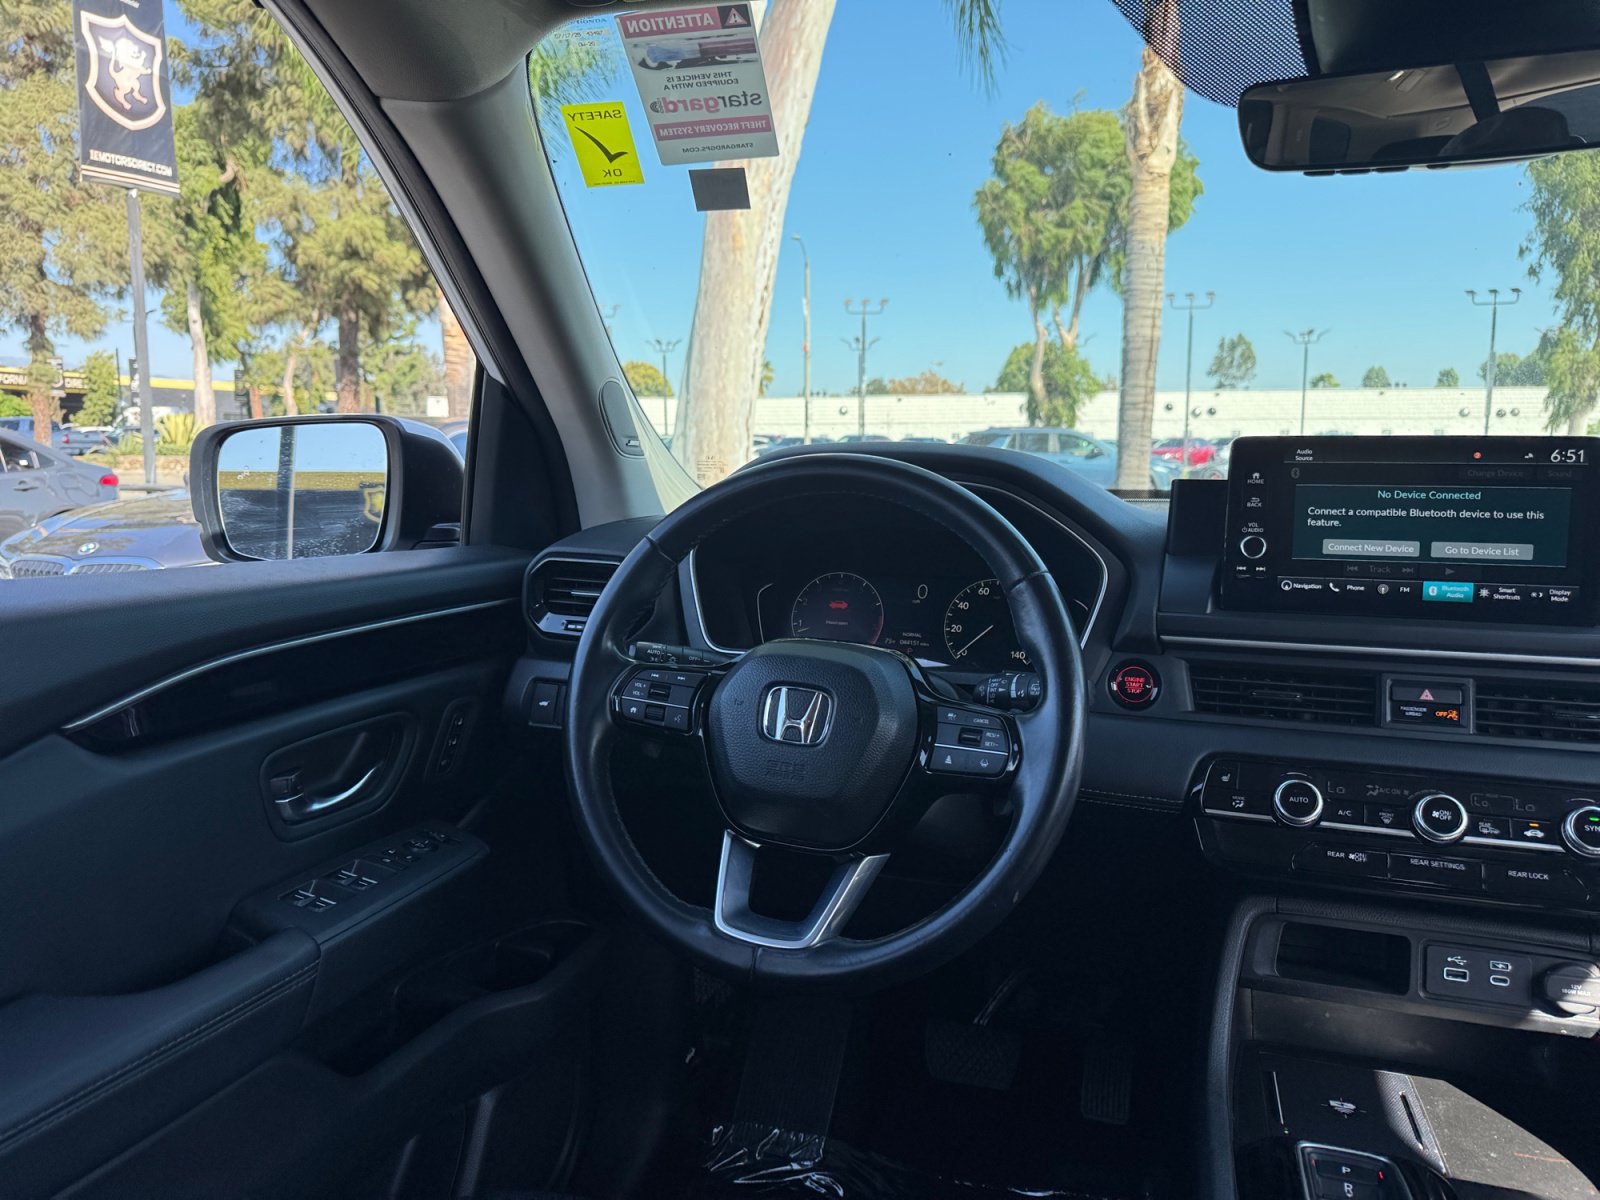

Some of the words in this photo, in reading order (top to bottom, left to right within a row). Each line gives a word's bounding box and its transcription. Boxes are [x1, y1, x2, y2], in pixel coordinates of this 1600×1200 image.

[1550, 449, 1585, 463] 6:51
[1467, 469, 1496, 478] Change
[1497, 469, 1524, 478] Device
[1548, 469, 1573, 478] Sound
[1377, 490, 1392, 499] No
[1394, 490, 1427, 500] Device
[1429, 490, 1481, 501] Connected
[1307, 506, 1347, 517] Connect
[1356, 507, 1407, 519] compatible
[1409, 508, 1457, 519] Bluetooth
[1459, 509, 1491, 519] device
[1493, 510, 1504, 520] to
[1506, 512, 1524, 520] use
[1526, 510, 1544, 520] this
[1307, 518, 1342, 528] feature.
[1328, 542, 1362, 552] Connect
[1363, 543, 1383, 553] New
[1385, 543, 1414, 554] Device
[1445, 546, 1457, 556] Go
[1460, 547, 1468, 555] to
[1471, 546, 1500, 556] Device
[1503, 546, 1519, 557] List
[1369, 565, 1391, 573] Track
[917, 584, 929, 600] 0
[978, 587, 990, 596] 60
[1549, 589, 1571, 597] Display
[957, 601, 969, 610] 40
[951, 624, 962, 633] 20
[1010, 650, 1026, 660] 140
[1338, 809, 1352, 817] A/C
[1327, 850, 1345, 858] REAR
[1410, 858, 1429, 867] REAR
[1430, 860, 1465, 870] SETTINGS
[1508, 870, 1527, 878] REAR
[1529, 872, 1549, 880] LOCK
[1344, 1182, 1353, 1197] R
